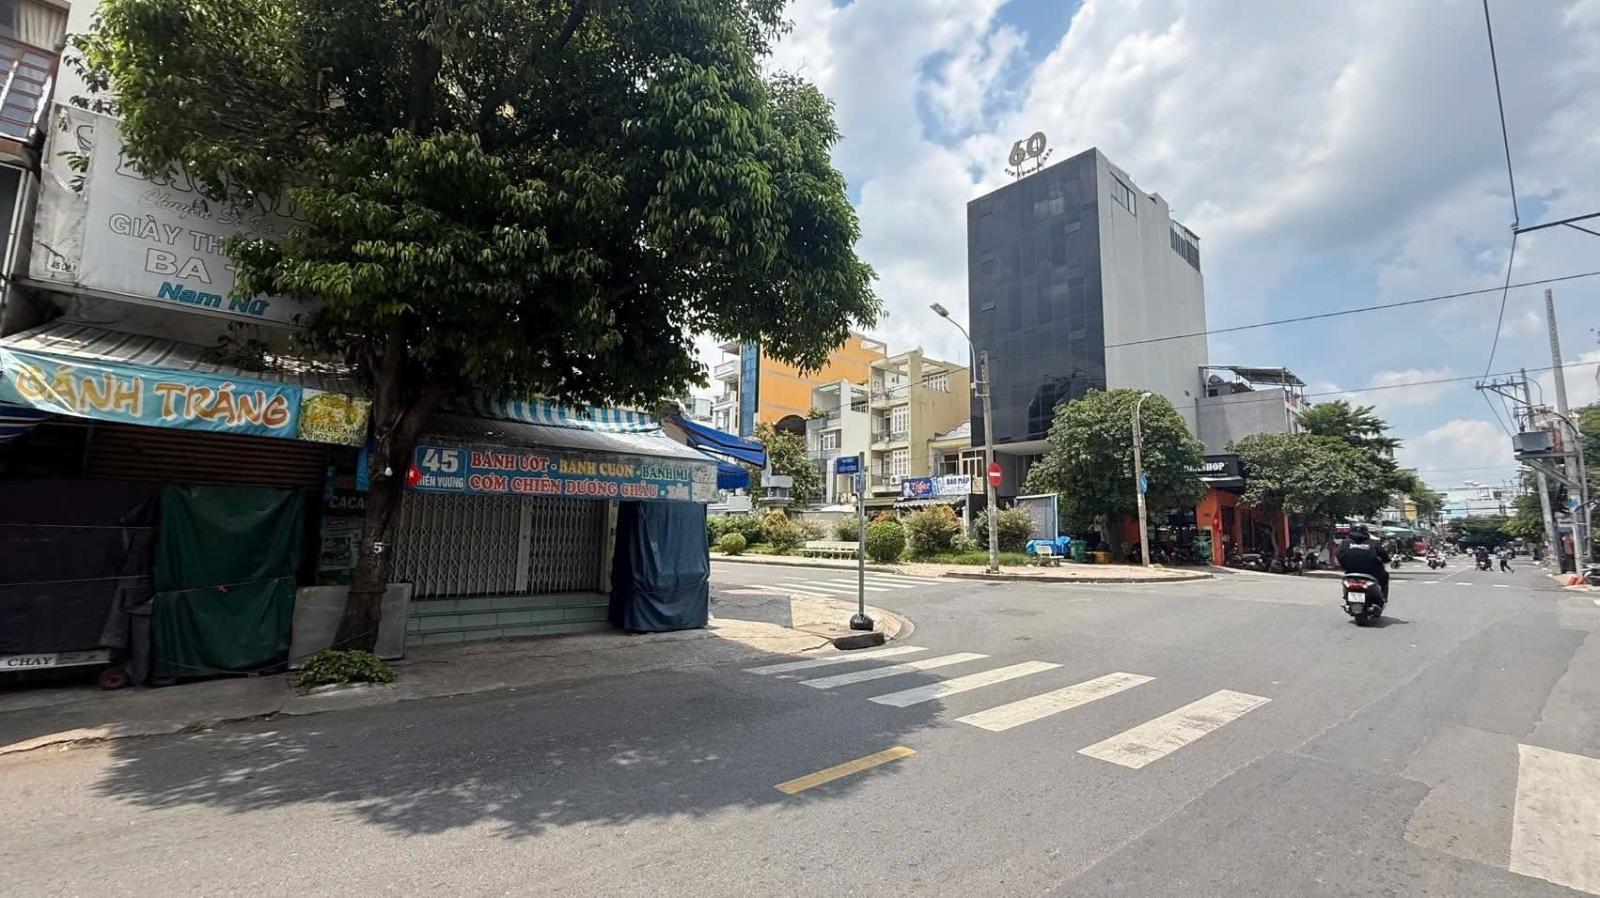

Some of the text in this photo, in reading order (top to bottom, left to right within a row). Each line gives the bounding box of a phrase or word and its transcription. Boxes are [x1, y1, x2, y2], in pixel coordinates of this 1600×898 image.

[1009, 131, 1046, 166] 60
[109, 213, 183, 245] GIÀY
[145, 248, 212, 284] BA
[157, 281, 222, 308] Nam
[153, 382, 292, 428] TRÁNG
[422, 448, 459, 473] 45
[471, 450, 517, 470] BÁNH
[469, 472, 508, 492] CƠM
[511, 474, 562, 495] CHIÊN
[565, 478, 618, 497] DƯƠNG
[621, 480, 659, 499] CHÂU
[7, 657, 52, 667] CHAY
